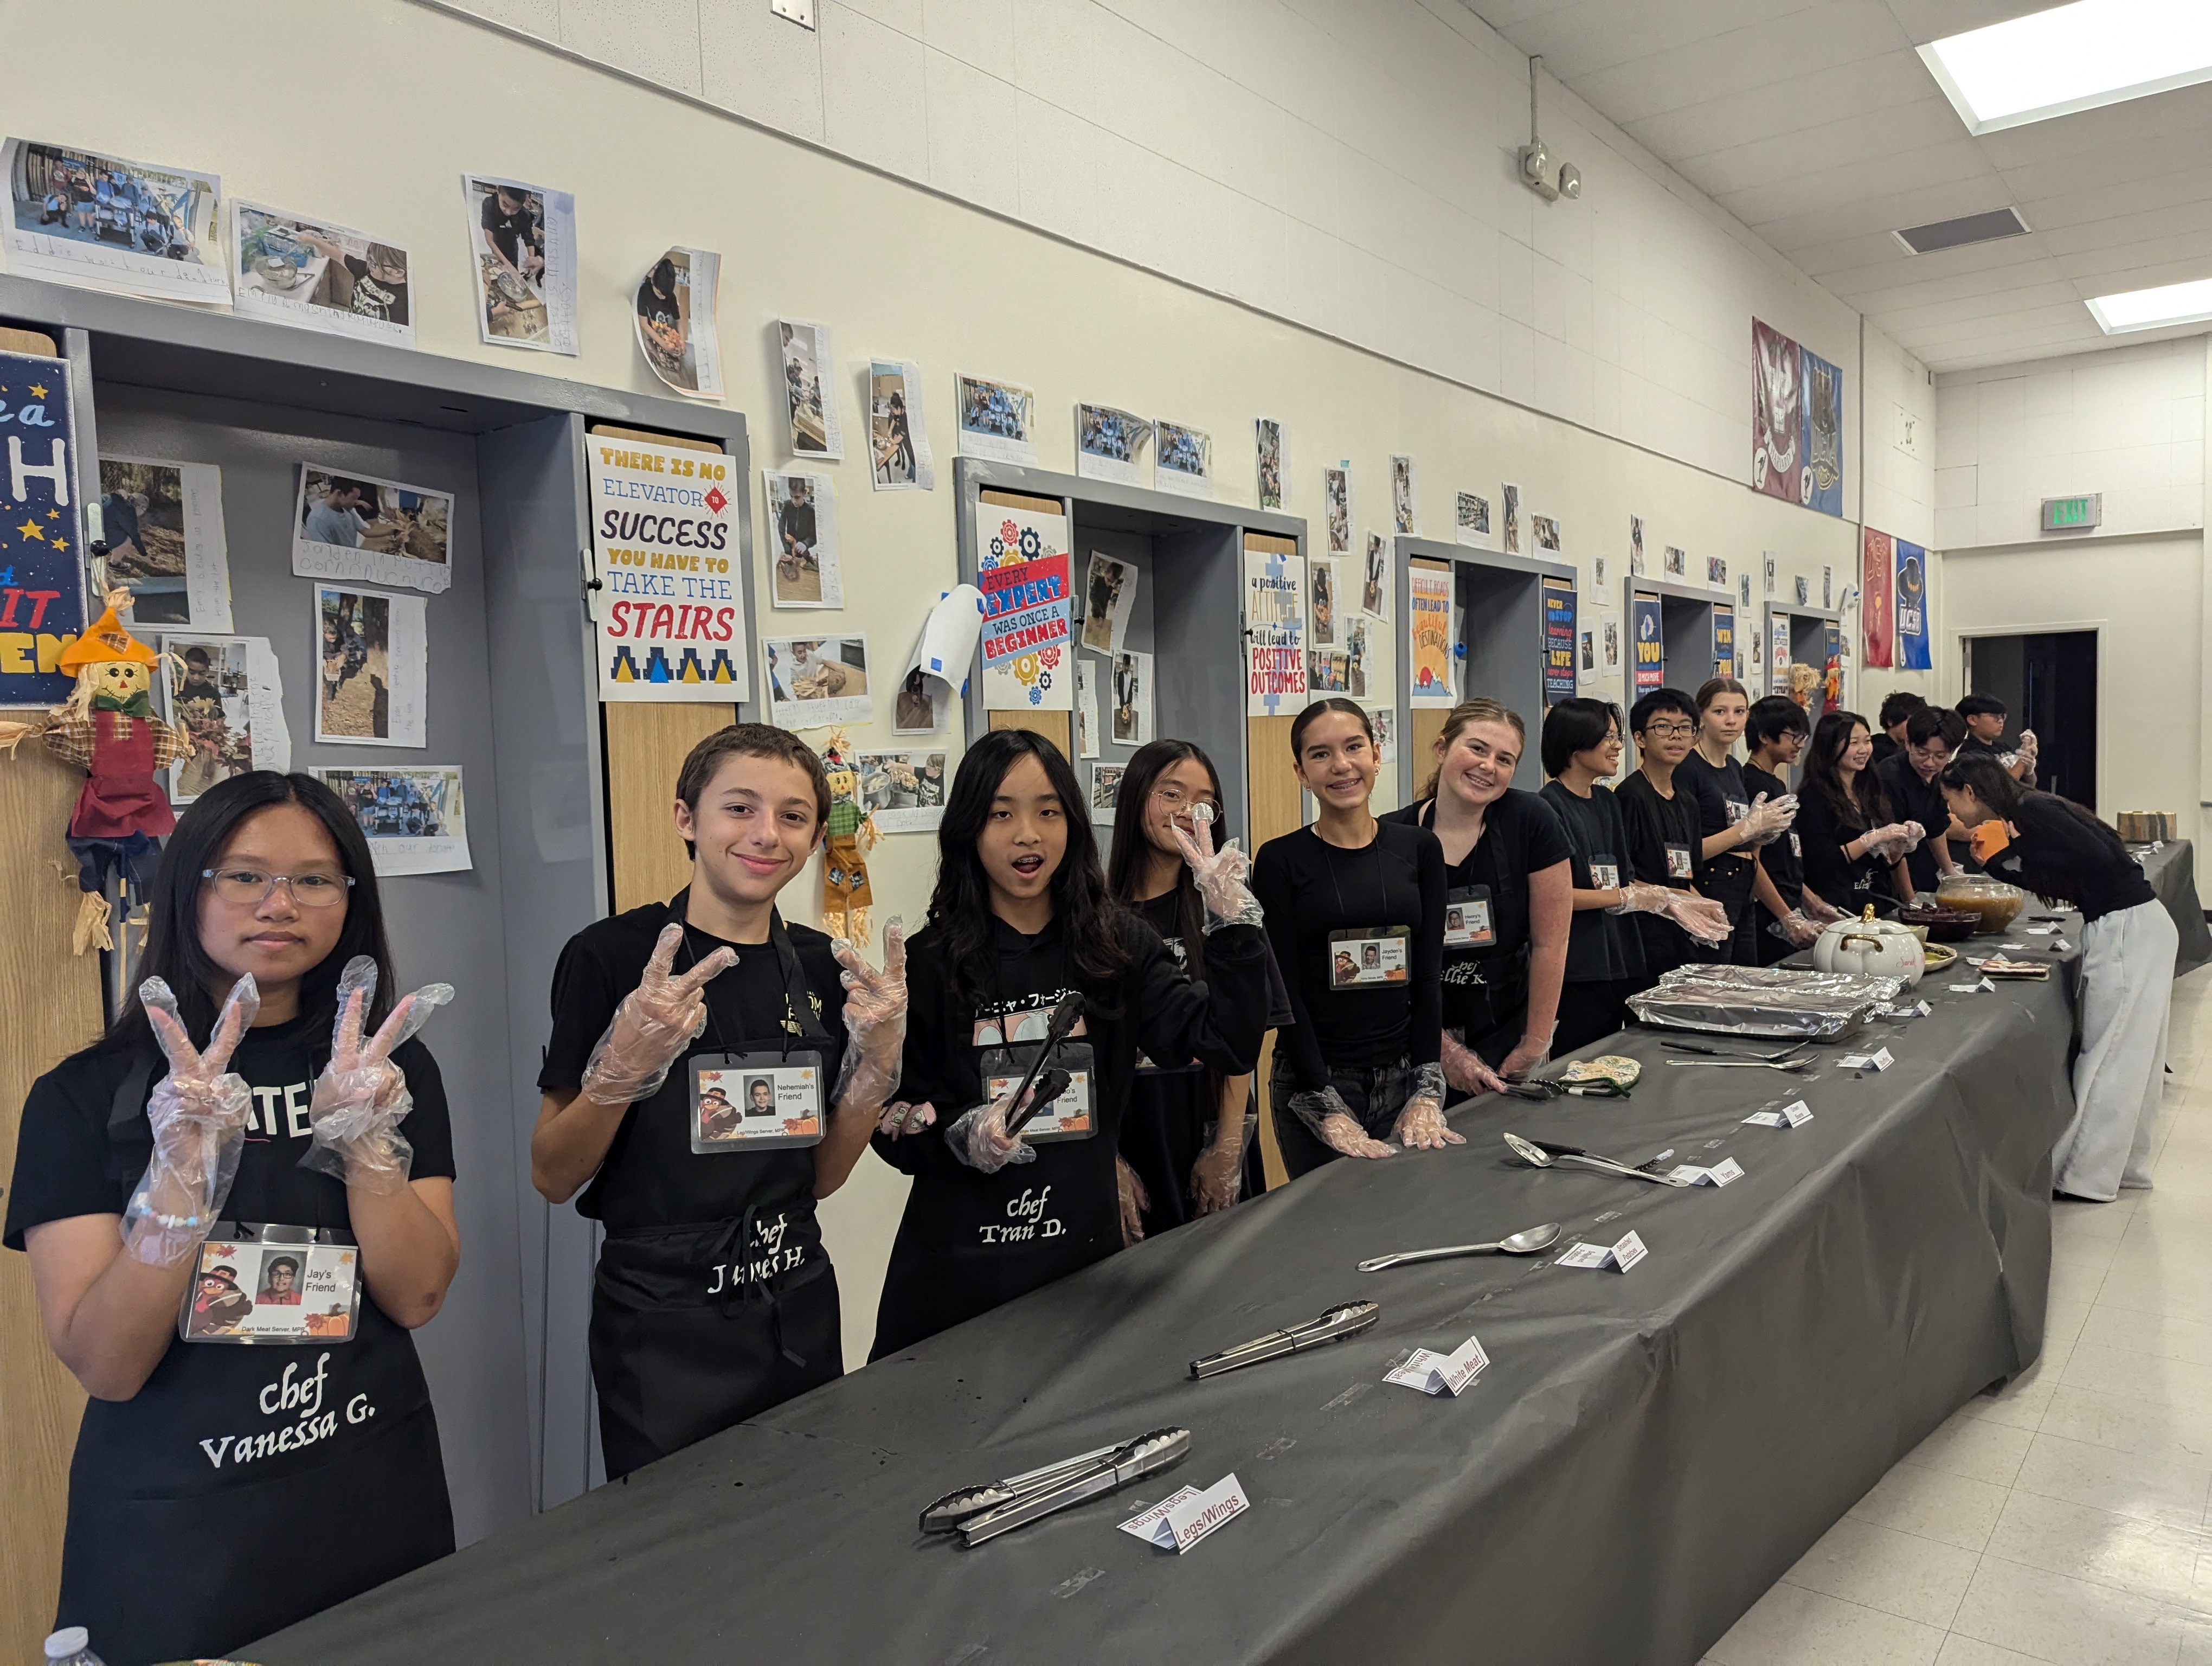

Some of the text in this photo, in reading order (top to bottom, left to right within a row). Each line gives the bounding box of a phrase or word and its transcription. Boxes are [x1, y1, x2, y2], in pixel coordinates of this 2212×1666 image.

[600, 447, 726, 482] THERE IS NO
[602, 478, 719, 508] ELEVATOR TO
[2053, 499, 2088, 524] EXIT
[600, 509, 728, 550] SUCCESS
[607, 547, 729, 574] YOU HAVE TO
[607, 572, 733, 601] TAKE THE
[986, 566, 1028, 591] EVERY
[1251, 575, 1296, 592] a positive
[1433, 580, 1449, 598] ROADS
[985, 574, 1061, 617] EXPERT
[1412, 597, 1449, 614] OFTEN LEAD TO
[1547, 598, 1563, 610] NEVER
[607, 600, 736, 642] STAIRS
[992, 607, 1060, 634] WAS ONCE A
[983, 618, 1069, 661] BEGINNER
[1250, 629, 1301, 646] will lead to
[1418, 629, 1452, 660] DESTINATIONS
[1548, 637, 1573, 650] BECAUSE
[1252, 647, 1303, 671] POSITIVE
[1551, 650, 1572, 667] LIFE
[1637, 642, 1660, 663] YOU
[1251, 670, 1306, 695] OUTCOMES
[1546, 678, 1573, 689] TEACHING
[1439, 967, 1469, 985] llie
[778, 1092, 802, 1100] Friend
[1721, 1169, 1735, 1180] Yams
[1007, 1186, 1052, 1223] chef
[750, 1213, 788, 1255] hef
[979, 1218, 1066, 1243] Tran D.
[1616, 1235, 1632, 1252] Smashed
[1622, 1246, 1638, 1262] Potatoes
[305, 1282, 336, 1292] Friend
[307, 1269, 332, 1280] Jay's
[1448, 1354, 1482, 1388] White Meat
[259, 1353, 330, 1417] chef
[200, 1393, 376, 1469] Vanessa G.
[1175, 1495, 1239, 1545] Legs/Wings
